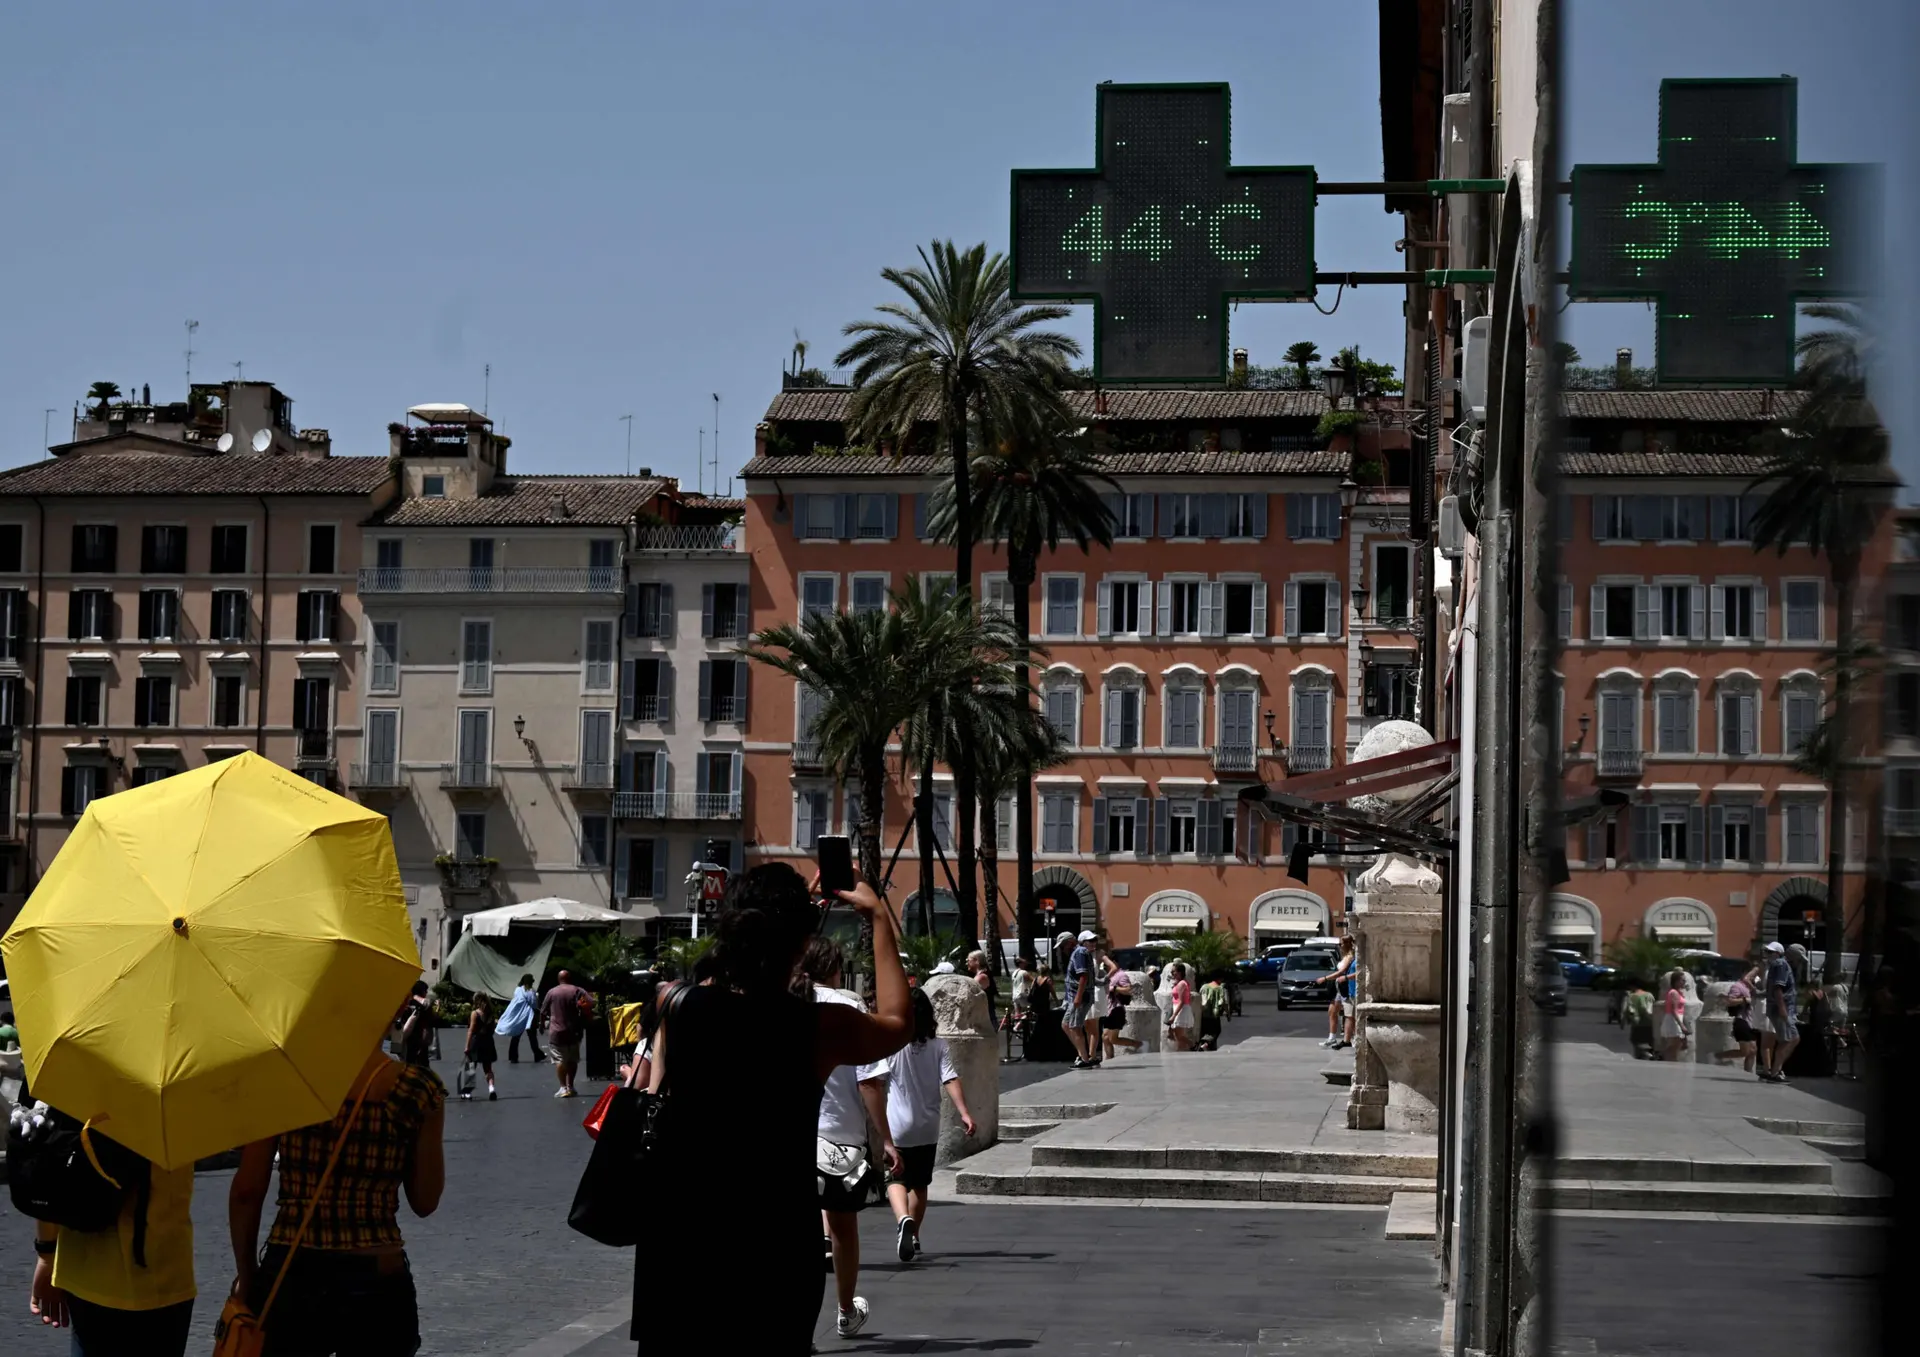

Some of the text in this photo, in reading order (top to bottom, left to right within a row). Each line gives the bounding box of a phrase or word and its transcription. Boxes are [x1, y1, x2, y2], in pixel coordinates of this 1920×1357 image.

[1061, 204, 1261, 262] 44°C
[702, 876, 724, 894] M
[1156, 903, 1195, 913] FRETTE
[1270, 905, 1310, 915] FRETTE
